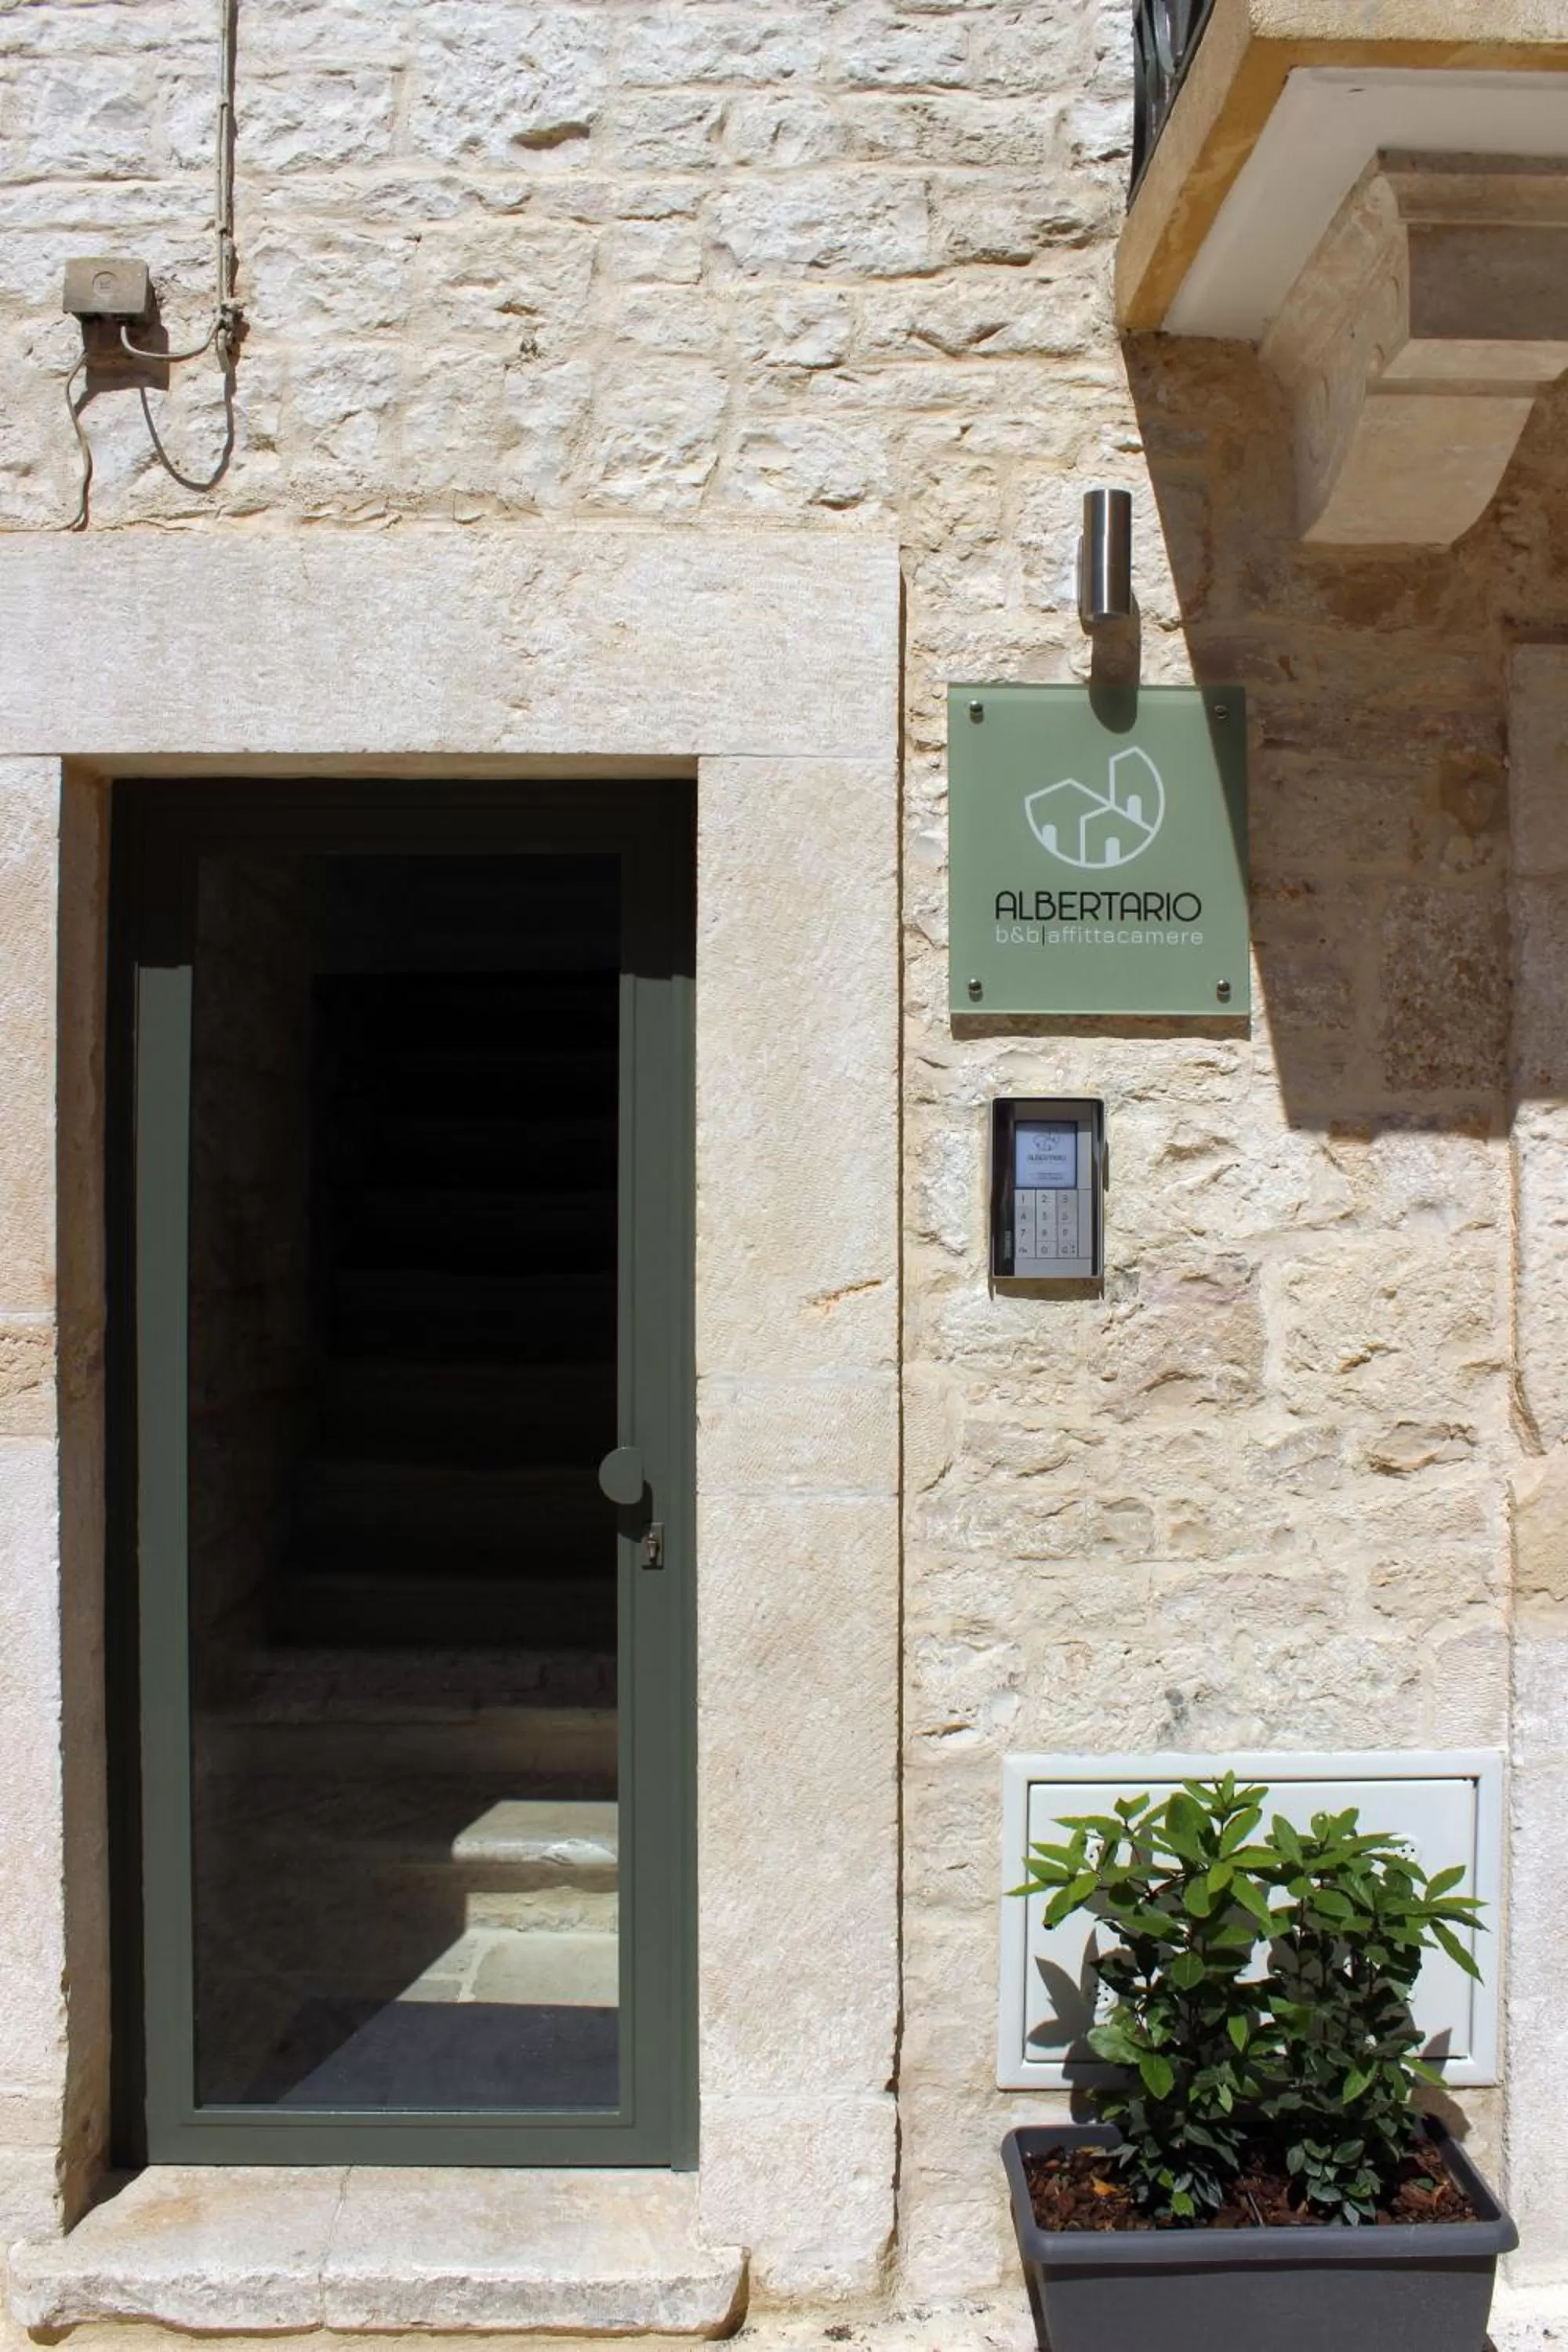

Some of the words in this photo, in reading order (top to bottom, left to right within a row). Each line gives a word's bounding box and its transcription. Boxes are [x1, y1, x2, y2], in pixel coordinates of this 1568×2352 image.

[995, 891, 1202, 922] ALBERTARIO
[1040, 1194, 1048, 1203] 2
[1062, 1194, 1068, 1203] 3
